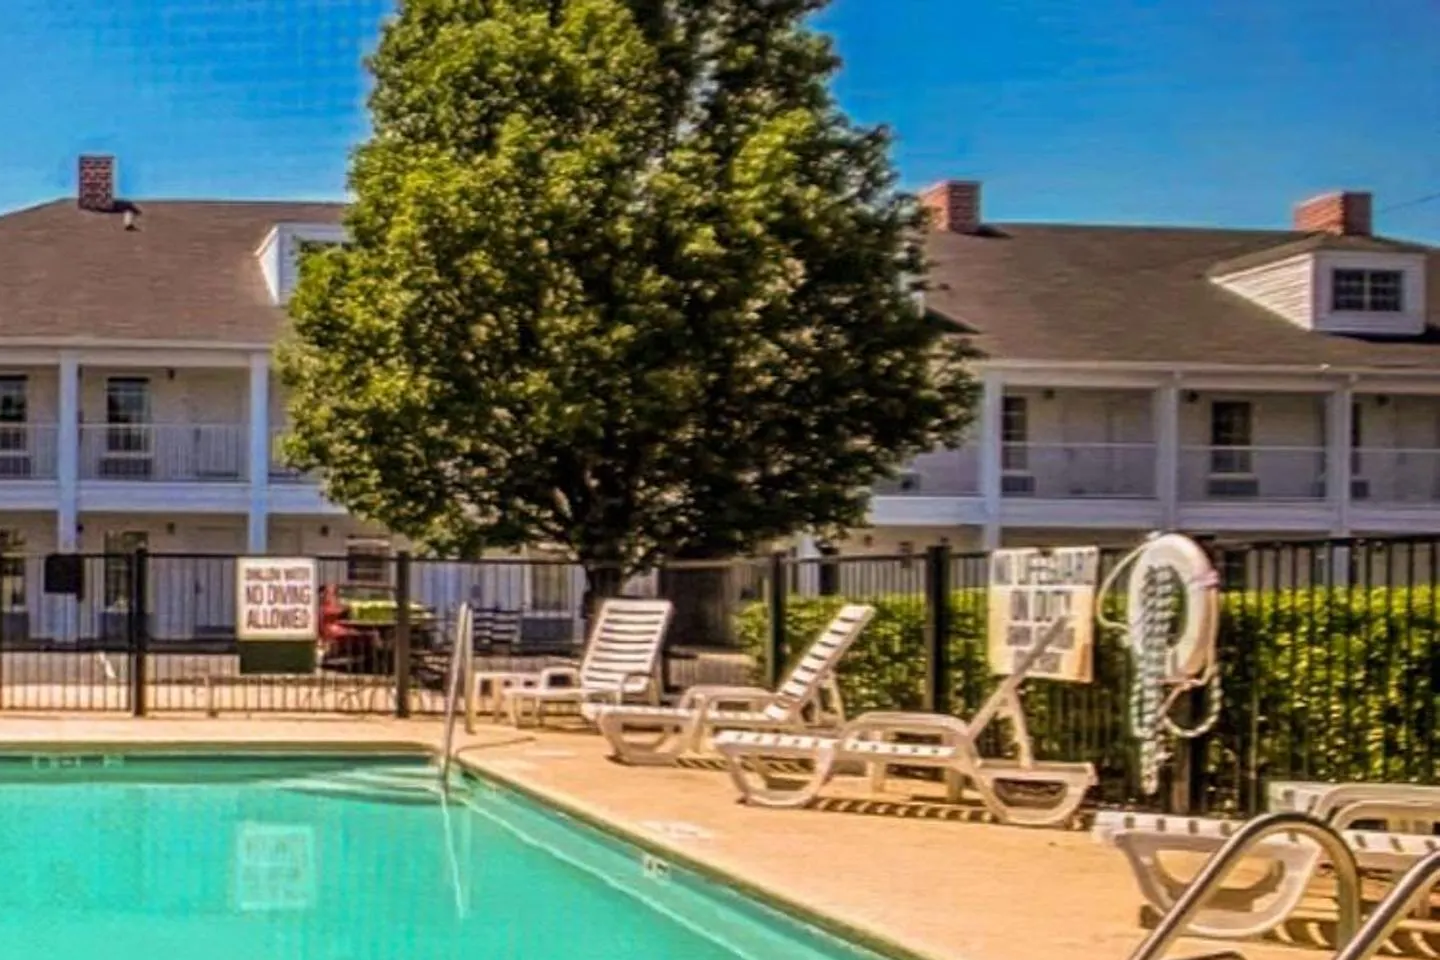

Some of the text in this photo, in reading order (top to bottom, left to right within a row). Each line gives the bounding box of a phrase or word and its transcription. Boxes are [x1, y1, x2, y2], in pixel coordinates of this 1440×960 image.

[246, 584, 311, 605] NO DIVING
[246, 608, 310, 629] ALLOWED
